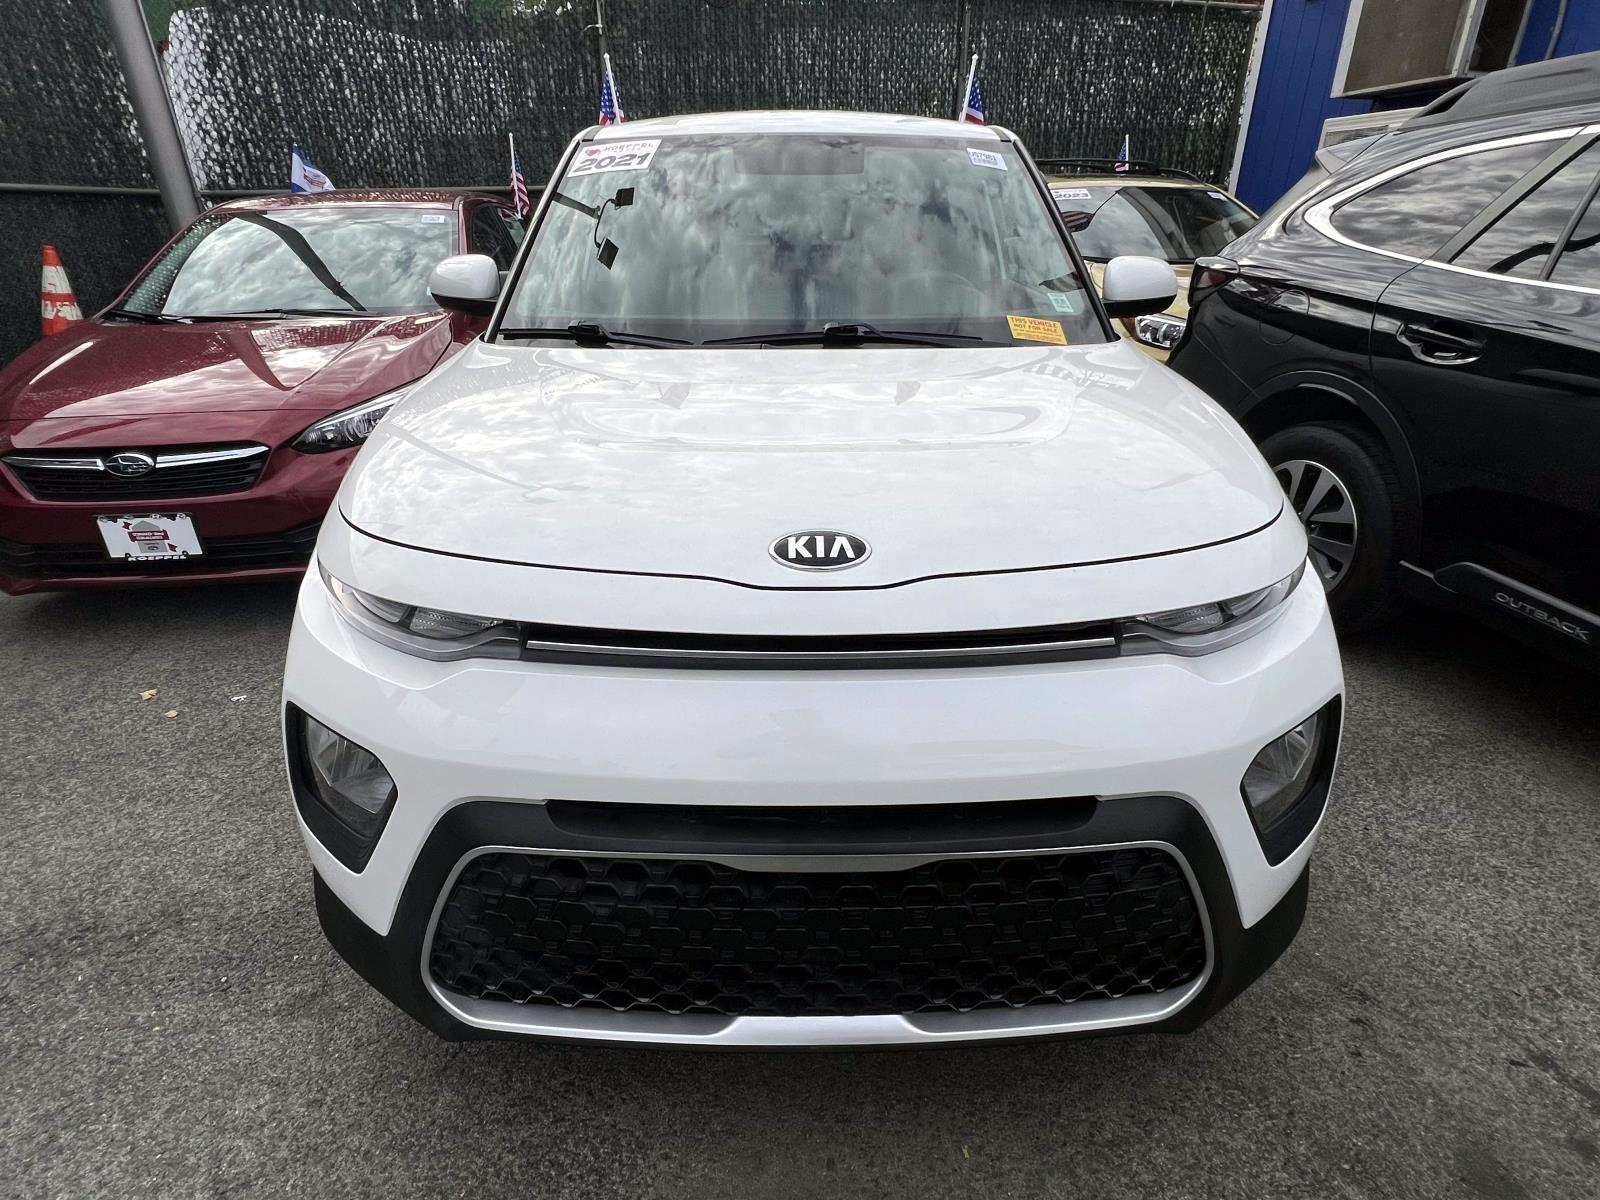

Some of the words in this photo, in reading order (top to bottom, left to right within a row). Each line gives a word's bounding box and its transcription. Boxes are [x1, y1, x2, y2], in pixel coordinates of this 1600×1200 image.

[573, 153, 651, 173] 2021
[1011, 317, 1028, 325] THIS
[1029, 319, 1057, 329] VEHICLE
[786, 535, 856, 559] KIA
[127, 554, 188, 562] KOEPPEL
[1495, 592, 1591, 641] OUTBACK
